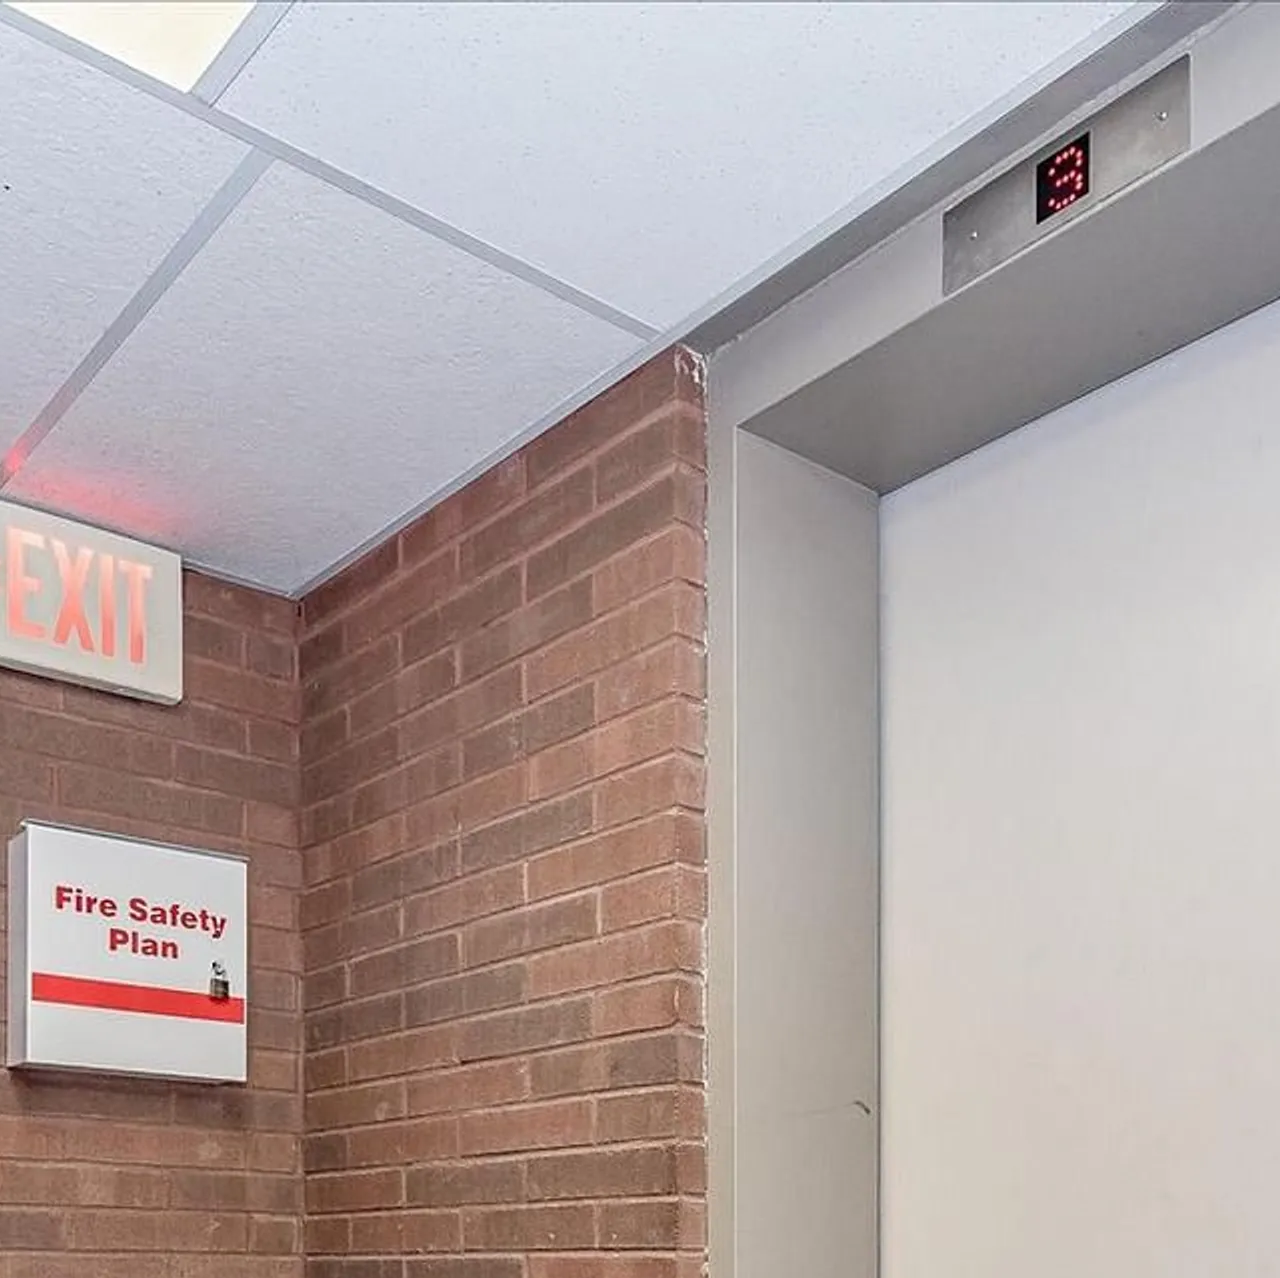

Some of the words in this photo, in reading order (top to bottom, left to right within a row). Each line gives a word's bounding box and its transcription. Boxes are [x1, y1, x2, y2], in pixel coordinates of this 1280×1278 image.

[6, 526, 152, 664] EXIT
[54, 885, 118, 920] Fire
[128, 897, 228, 940] Safety
[108, 927, 179, 961] Plan
